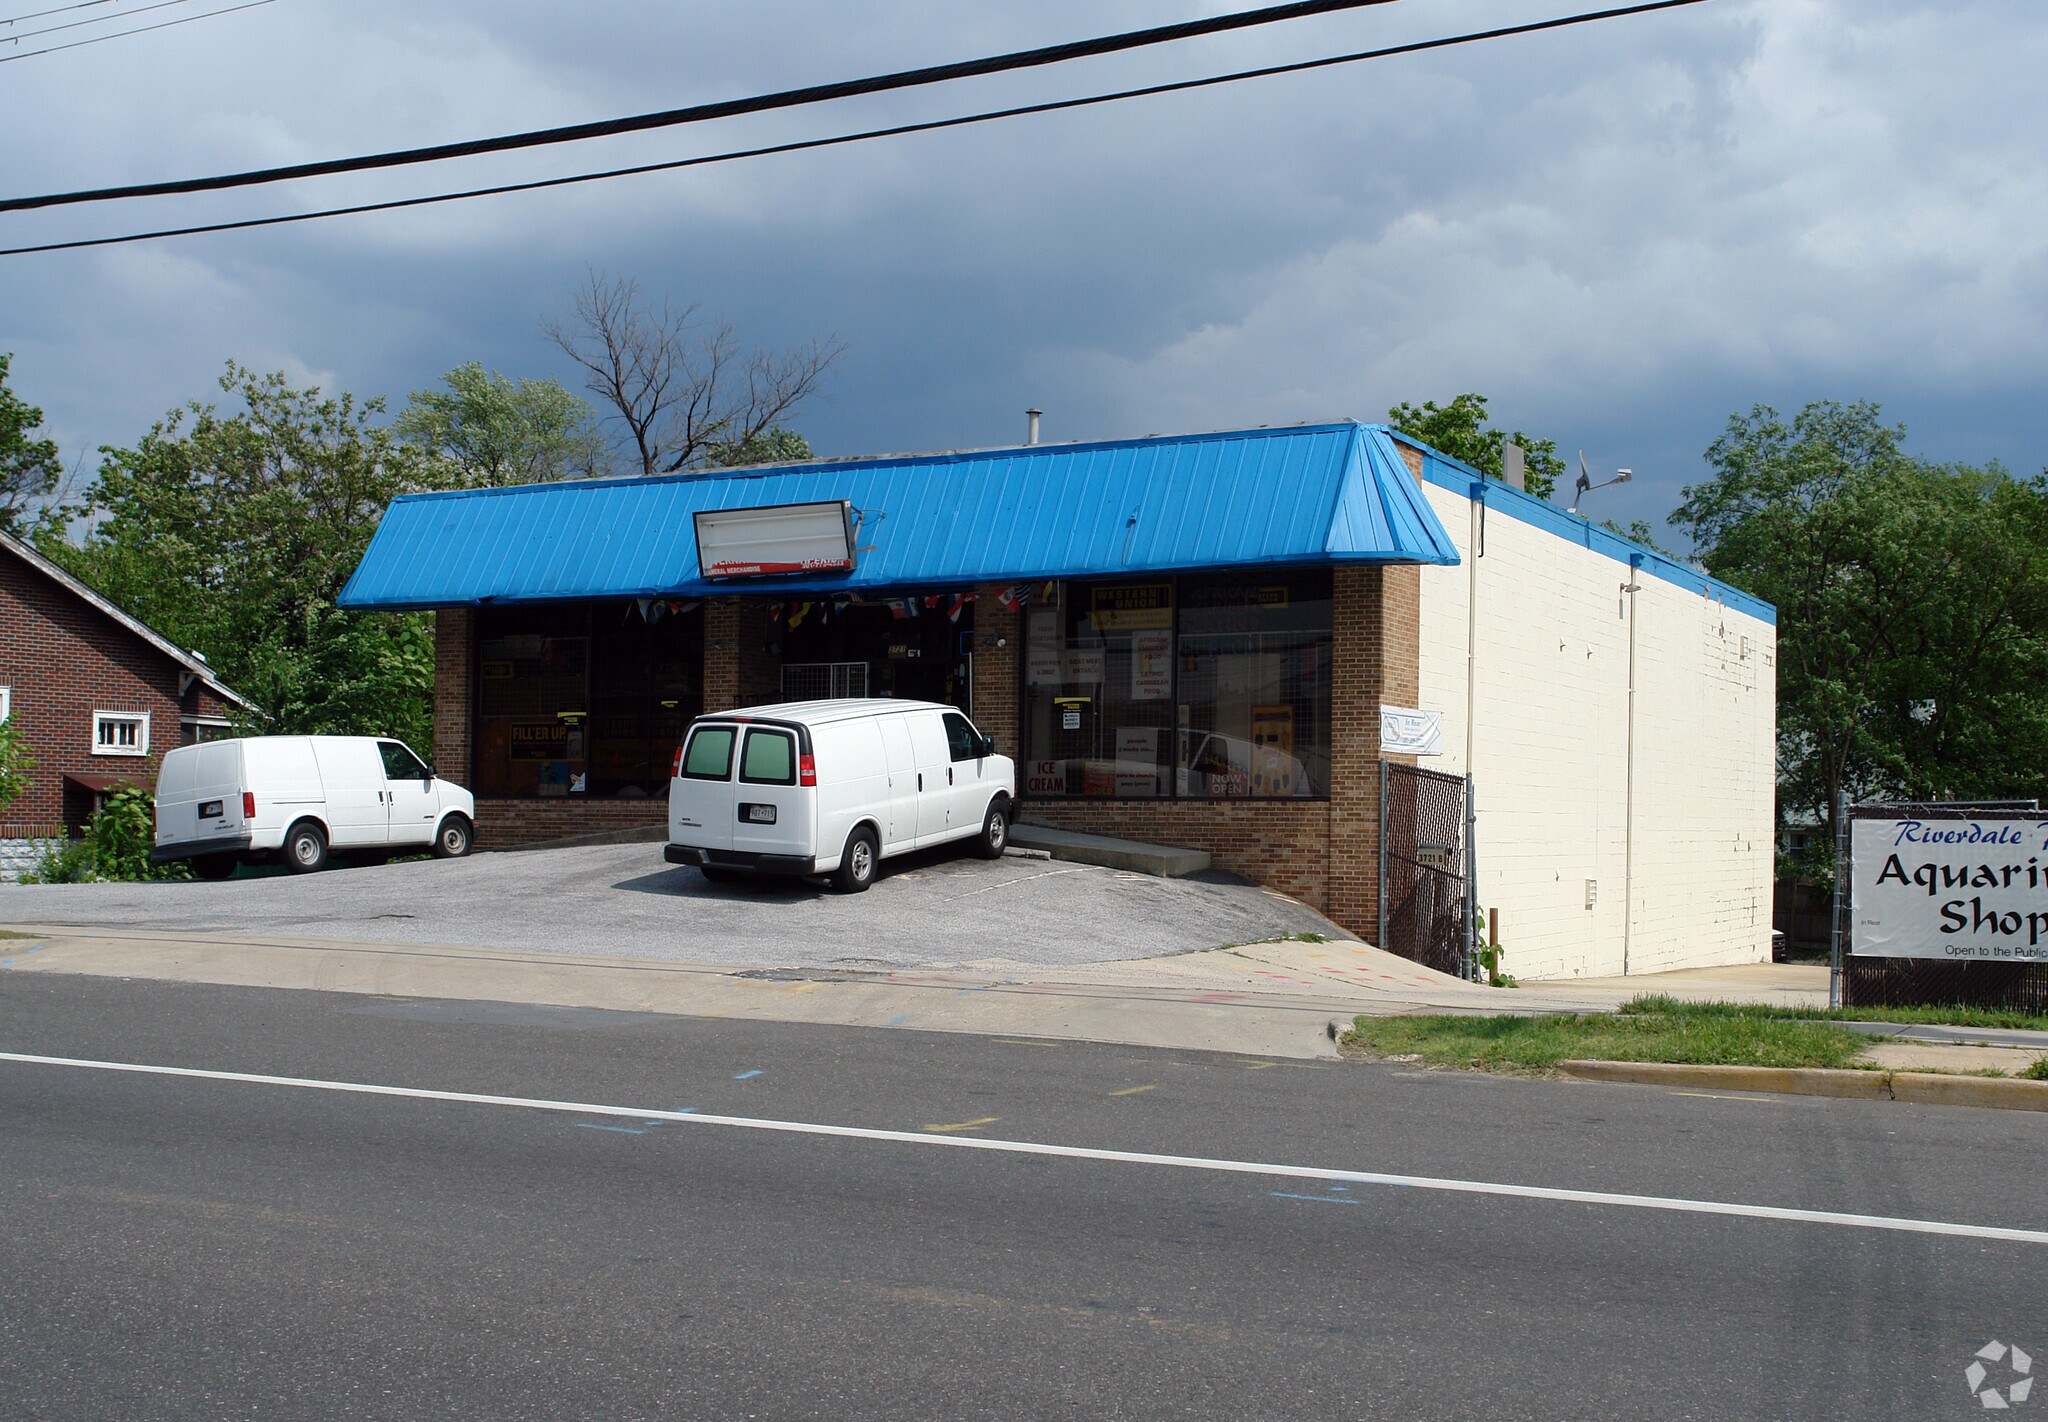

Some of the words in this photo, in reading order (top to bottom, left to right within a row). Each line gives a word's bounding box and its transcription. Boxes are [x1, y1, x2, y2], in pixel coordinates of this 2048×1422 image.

[1096, 588, 1157, 600] WESTERN
[1116, 599, 1157, 608] UNION
[512, 726, 549, 741] FILL'ER
[552, 726, 567, 741] UP.
[1037, 762, 1056, 774] ICE
[1028, 778, 1064, 792] CREAM
[1212, 774, 1242, 784] NOW
[1212, 784, 1242, 794] OPEN
[1894, 821, 2022, 846] Riverdale
[1419, 853, 1436, 863] 3721
[1875, 853, 2048, 896] Aquari
[1939, 896, 2048, 945] Shop
[1945, 944, 1976, 958] Open
[1979, 946, 1990, 956] to
[1994, 945, 2012, 957] the
[2015, 947, 2048, 958] Public
